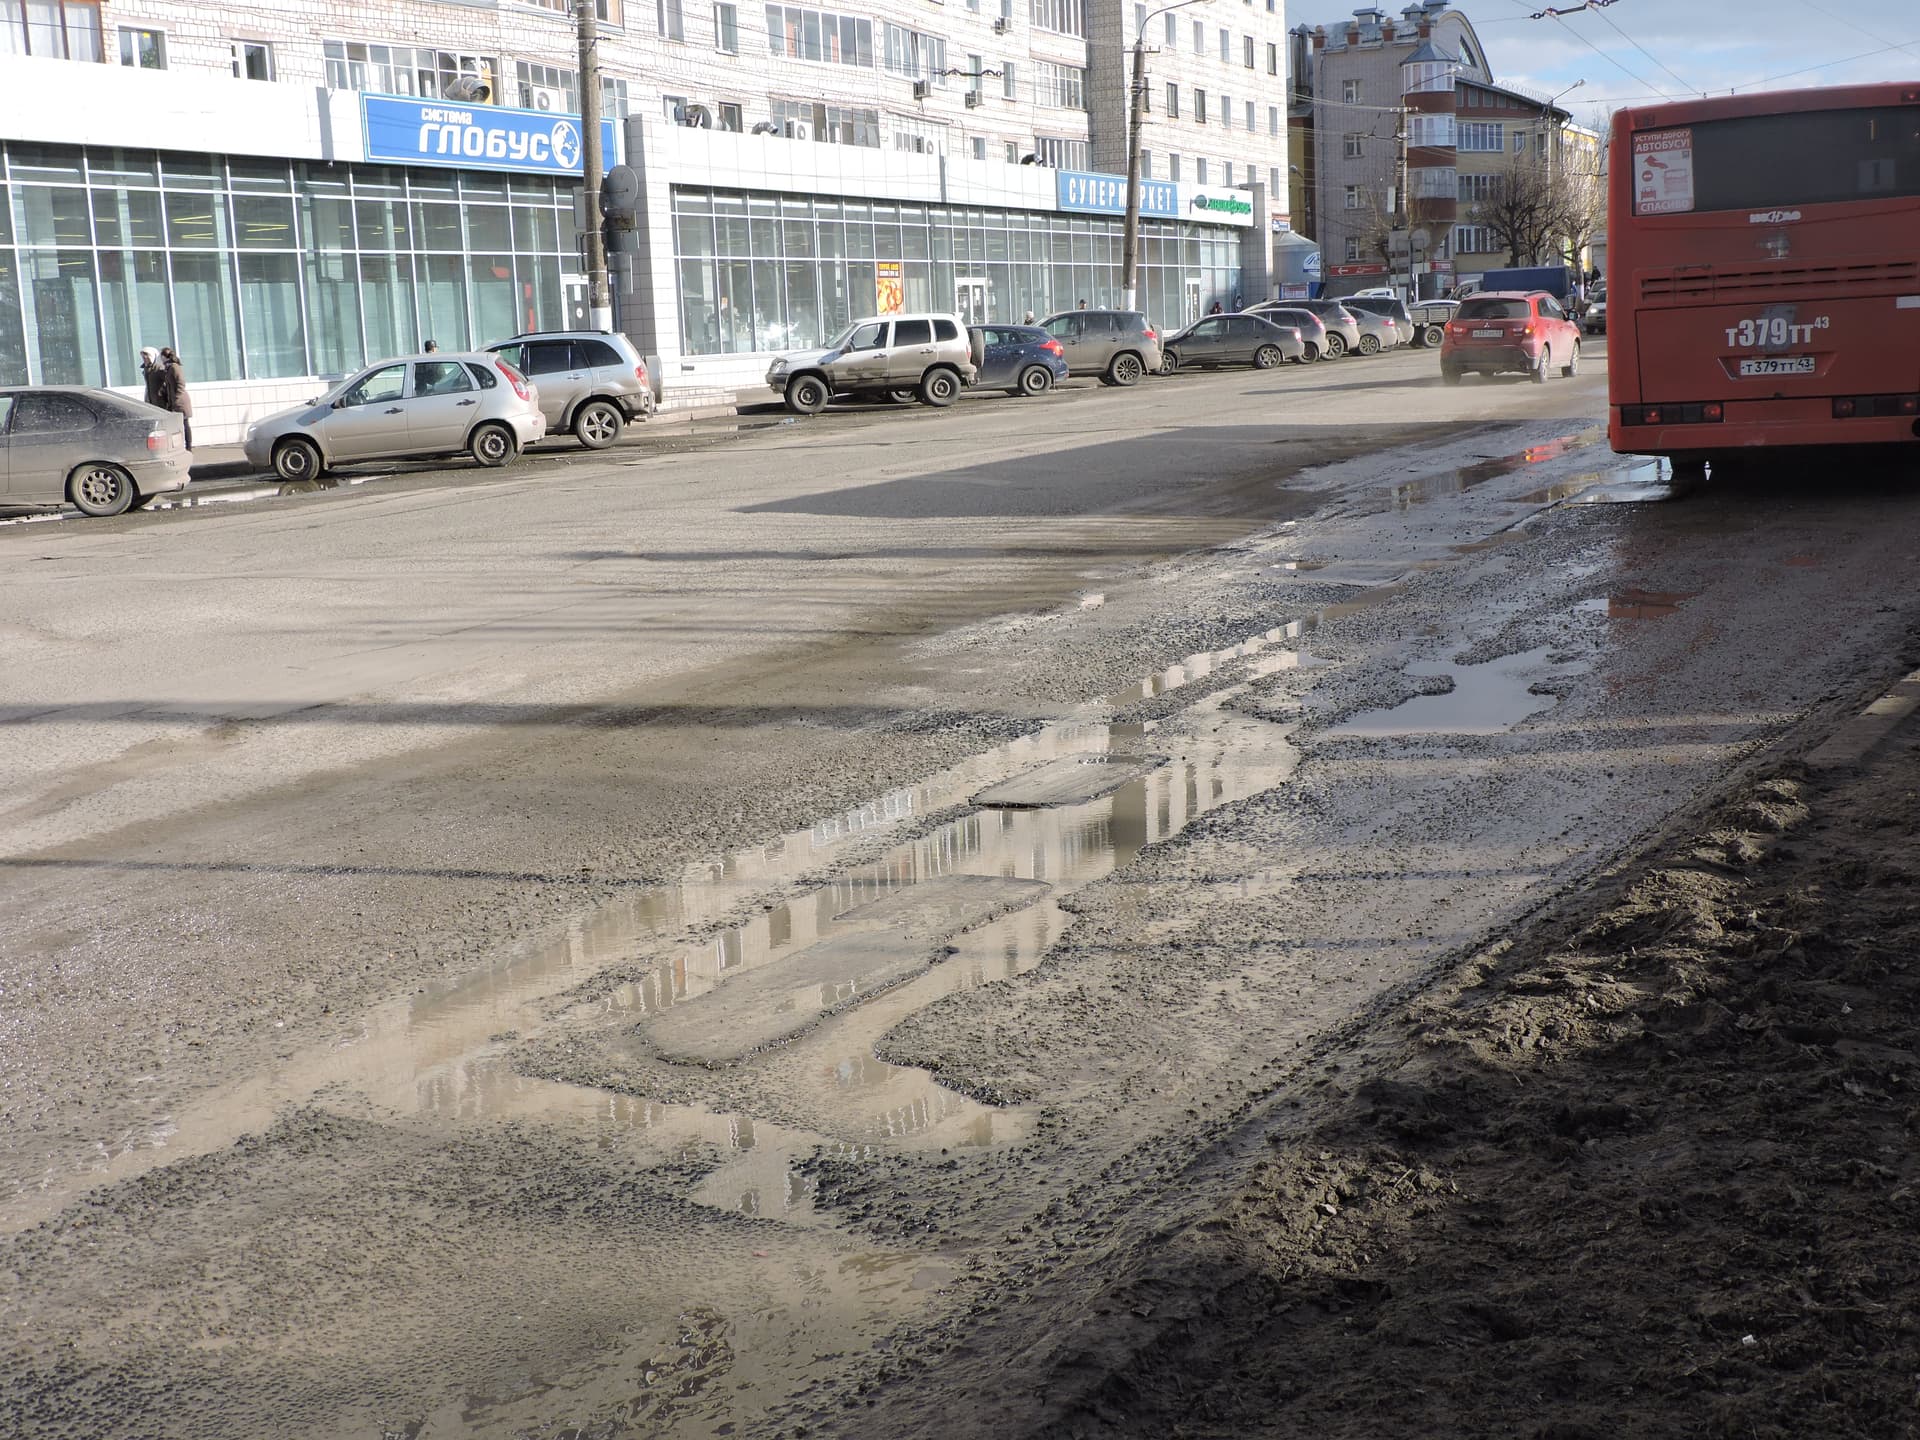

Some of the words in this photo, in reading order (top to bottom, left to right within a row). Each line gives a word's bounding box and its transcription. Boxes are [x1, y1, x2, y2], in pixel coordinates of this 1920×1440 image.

[419, 123, 549, 161] ГЛОБУС
[1636, 138, 1690, 152] АВТОБУСУ!
[1069, 177, 1171, 211] СУПЕРМРКЕТ
